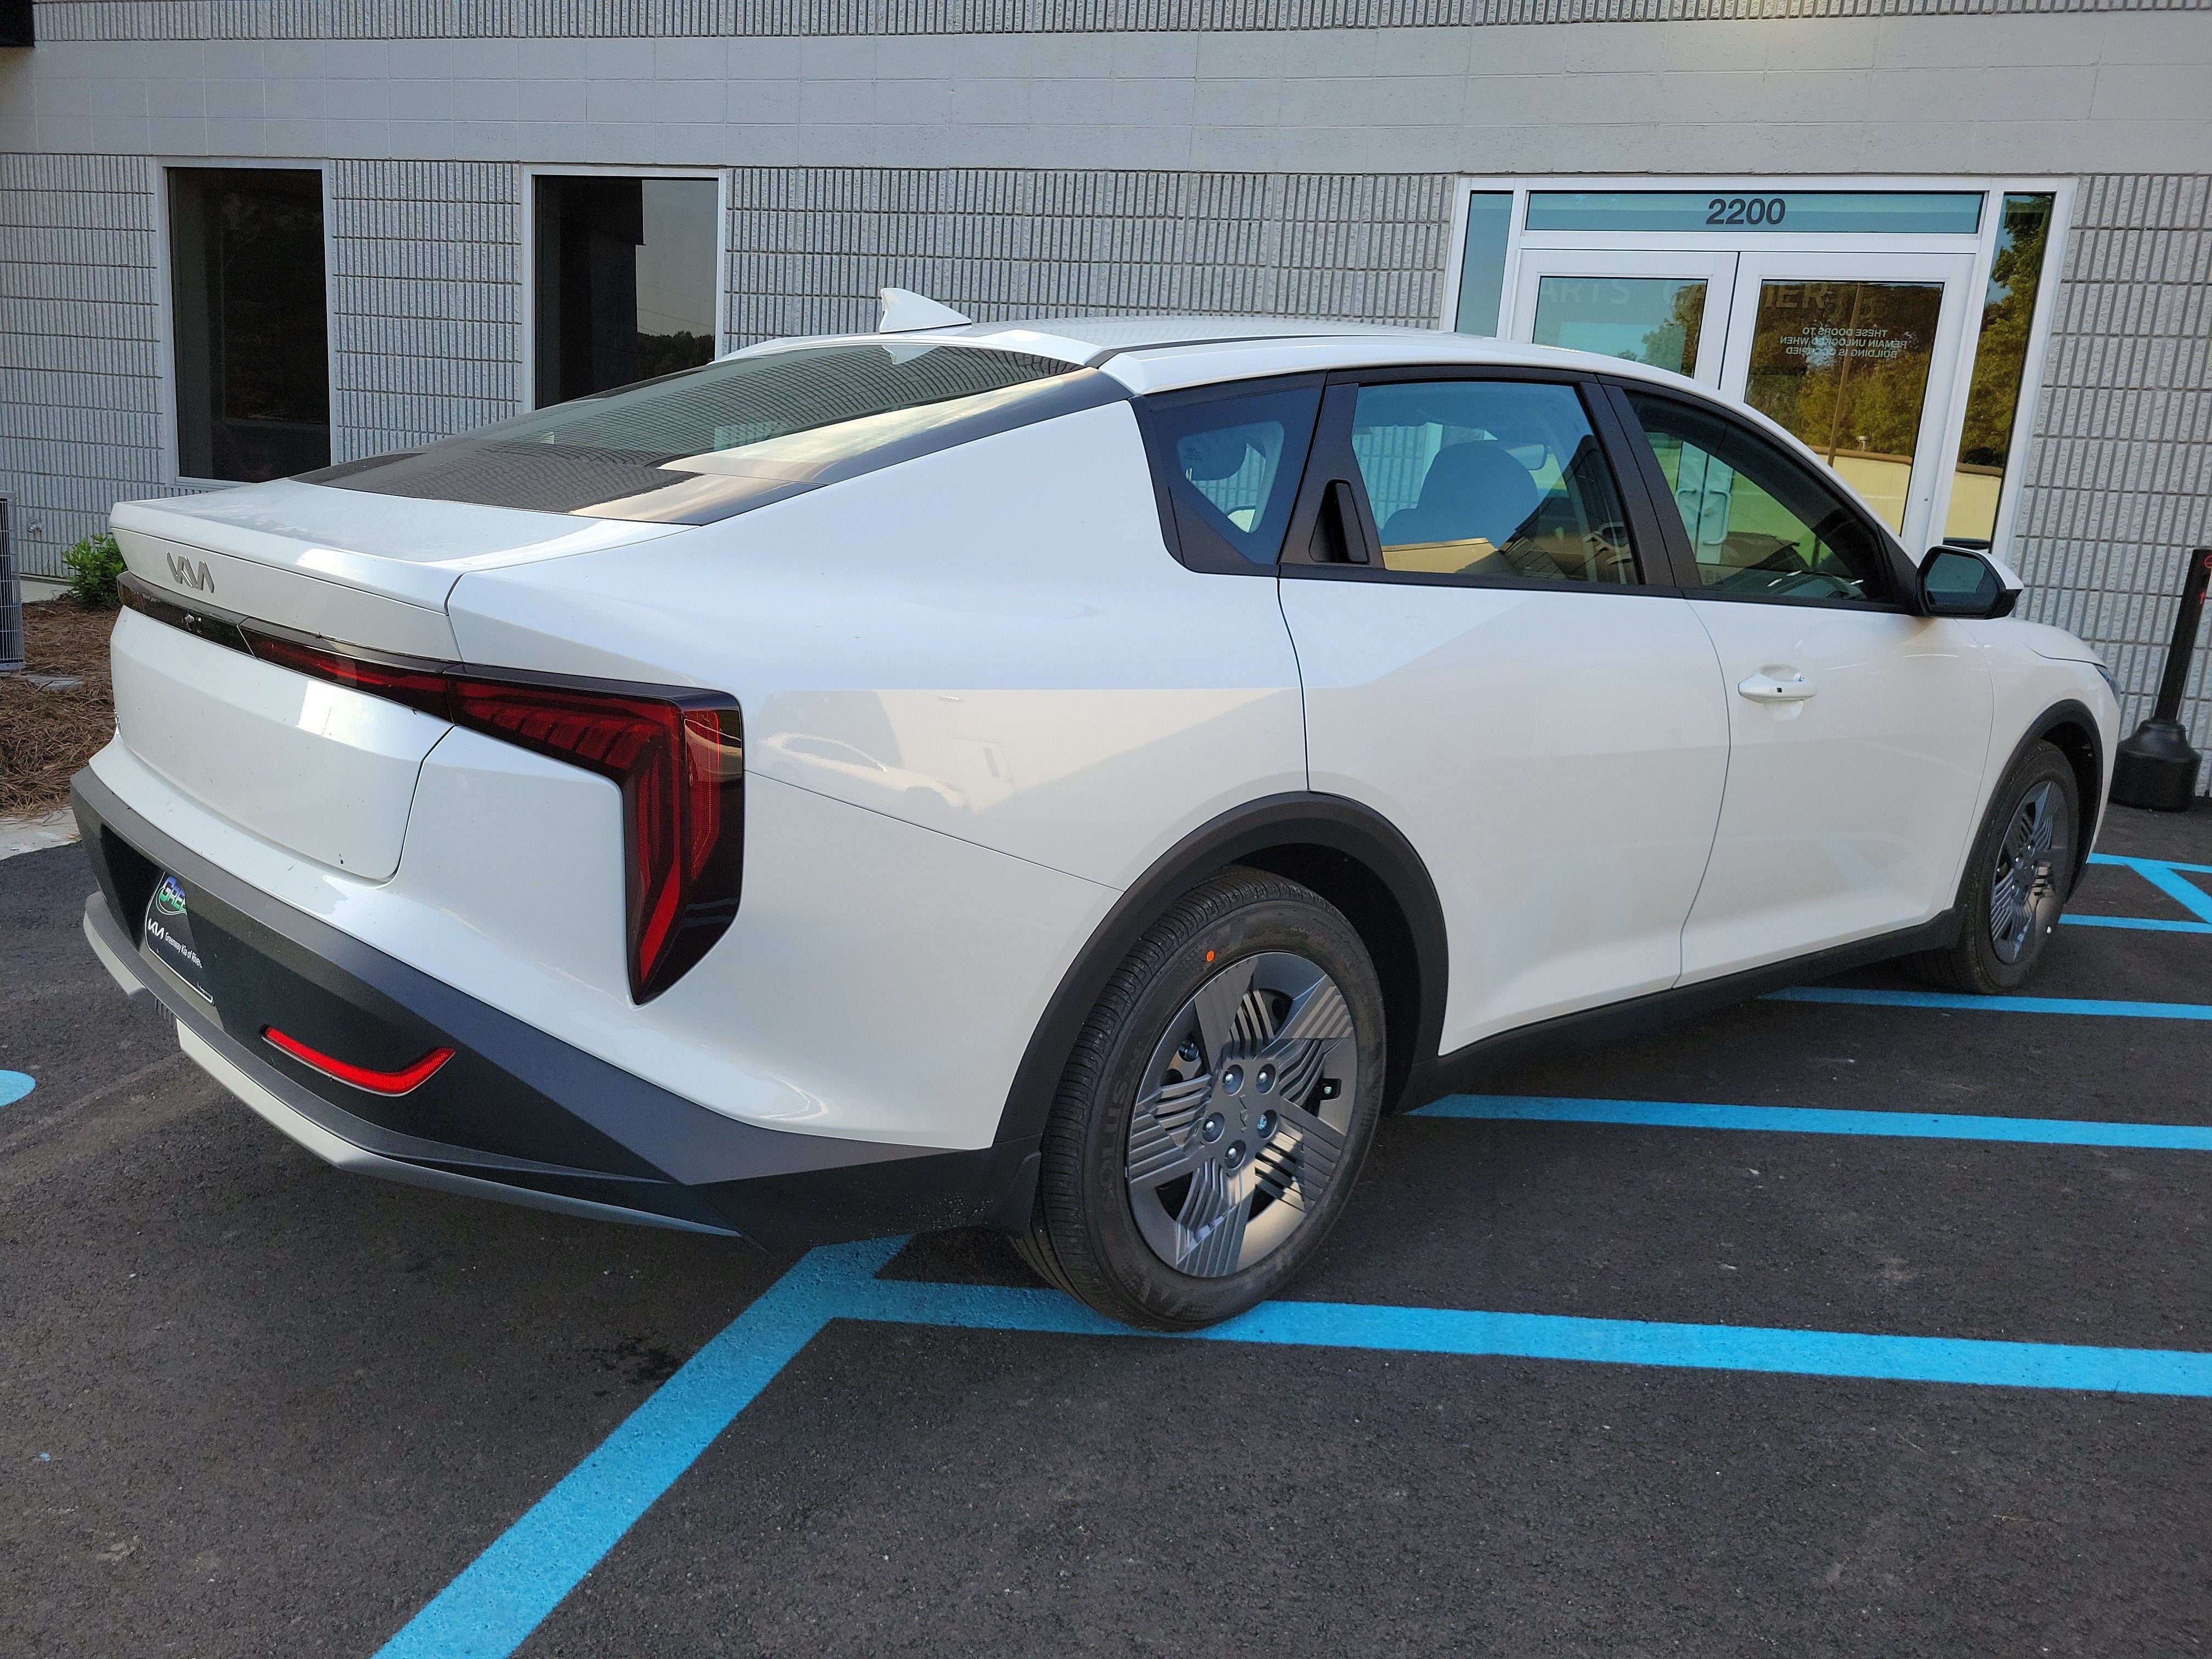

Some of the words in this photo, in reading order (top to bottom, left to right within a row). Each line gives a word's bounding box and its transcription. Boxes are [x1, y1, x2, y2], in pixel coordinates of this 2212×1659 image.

[1706, 198, 1786, 224] 2200
[1541, 278, 1632, 306] ARTS
[167, 551, 215, 593] KIA
[148, 918, 165, 940] KIA
[165, 932, 182, 953] Greenway
[187, 950, 193, 959] of
